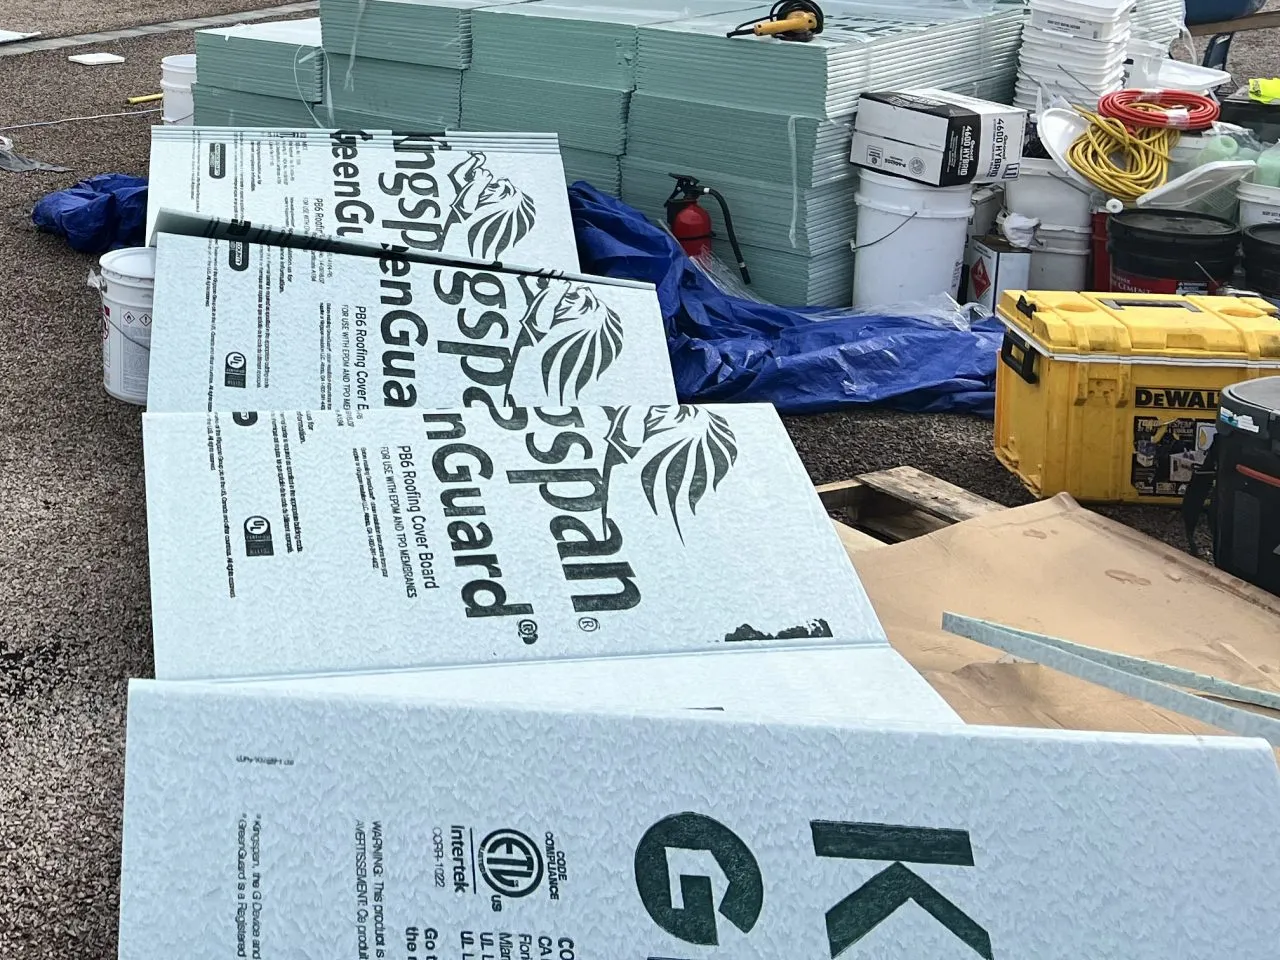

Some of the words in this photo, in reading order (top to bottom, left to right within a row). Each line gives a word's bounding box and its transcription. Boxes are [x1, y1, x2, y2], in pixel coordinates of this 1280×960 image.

[964, 125, 973, 147] 4600
[996, 119, 1005, 143] 4600
[960, 148, 971, 176] HYBRID
[989, 145, 1003, 177] HYBRID
[341, 318, 350, 330] USE
[354, 306, 367, 327] PB6
[341, 332, 350, 348] WITH
[353, 329, 368, 368] Roofing
[356, 371, 369, 401] Cover
[1135, 389, 1221, 408] DEWAL
[380, 446, 391, 460] FOR
[397, 445, 415, 468] PB6
[383, 461, 394, 474] USE
[385, 476, 398, 493] WITH
[402, 470, 422, 513] Roofing
[388, 494, 402, 514] EPDM
[392, 515, 405, 532] AND
[411, 515, 429, 549] Cover
[396, 532, 408, 548] TPO
[400, 549, 417, 599] MEMBRANES
[418, 552, 440, 589] Board
[372, 820, 384, 878] WARNING:
[431, 826, 446, 889] CCRR-1022
[450, 825, 470, 894] Intertek
[354, 820, 369, 906] AVERTISSEMENT:
[544, 831, 560, 900] COMPLIANCE
[555, 850, 568, 881] CODE
[251, 872, 262, 889] the
[373, 881, 385, 903] This
[251, 891, 262, 900] G
[251, 901, 263, 937] Device
[356, 908, 369, 924] Ce
[372, 904, 386, 947] product
[234, 902, 248, 958] Registered
[405, 926, 420, 952] the
[424, 927, 439, 951] Go
[461, 930, 475, 949] UL
[480, 932, 494, 950] UL
[251, 939, 262, 960] and
[355, 925, 370, 960] produit
[538, 935, 553, 956] CA
